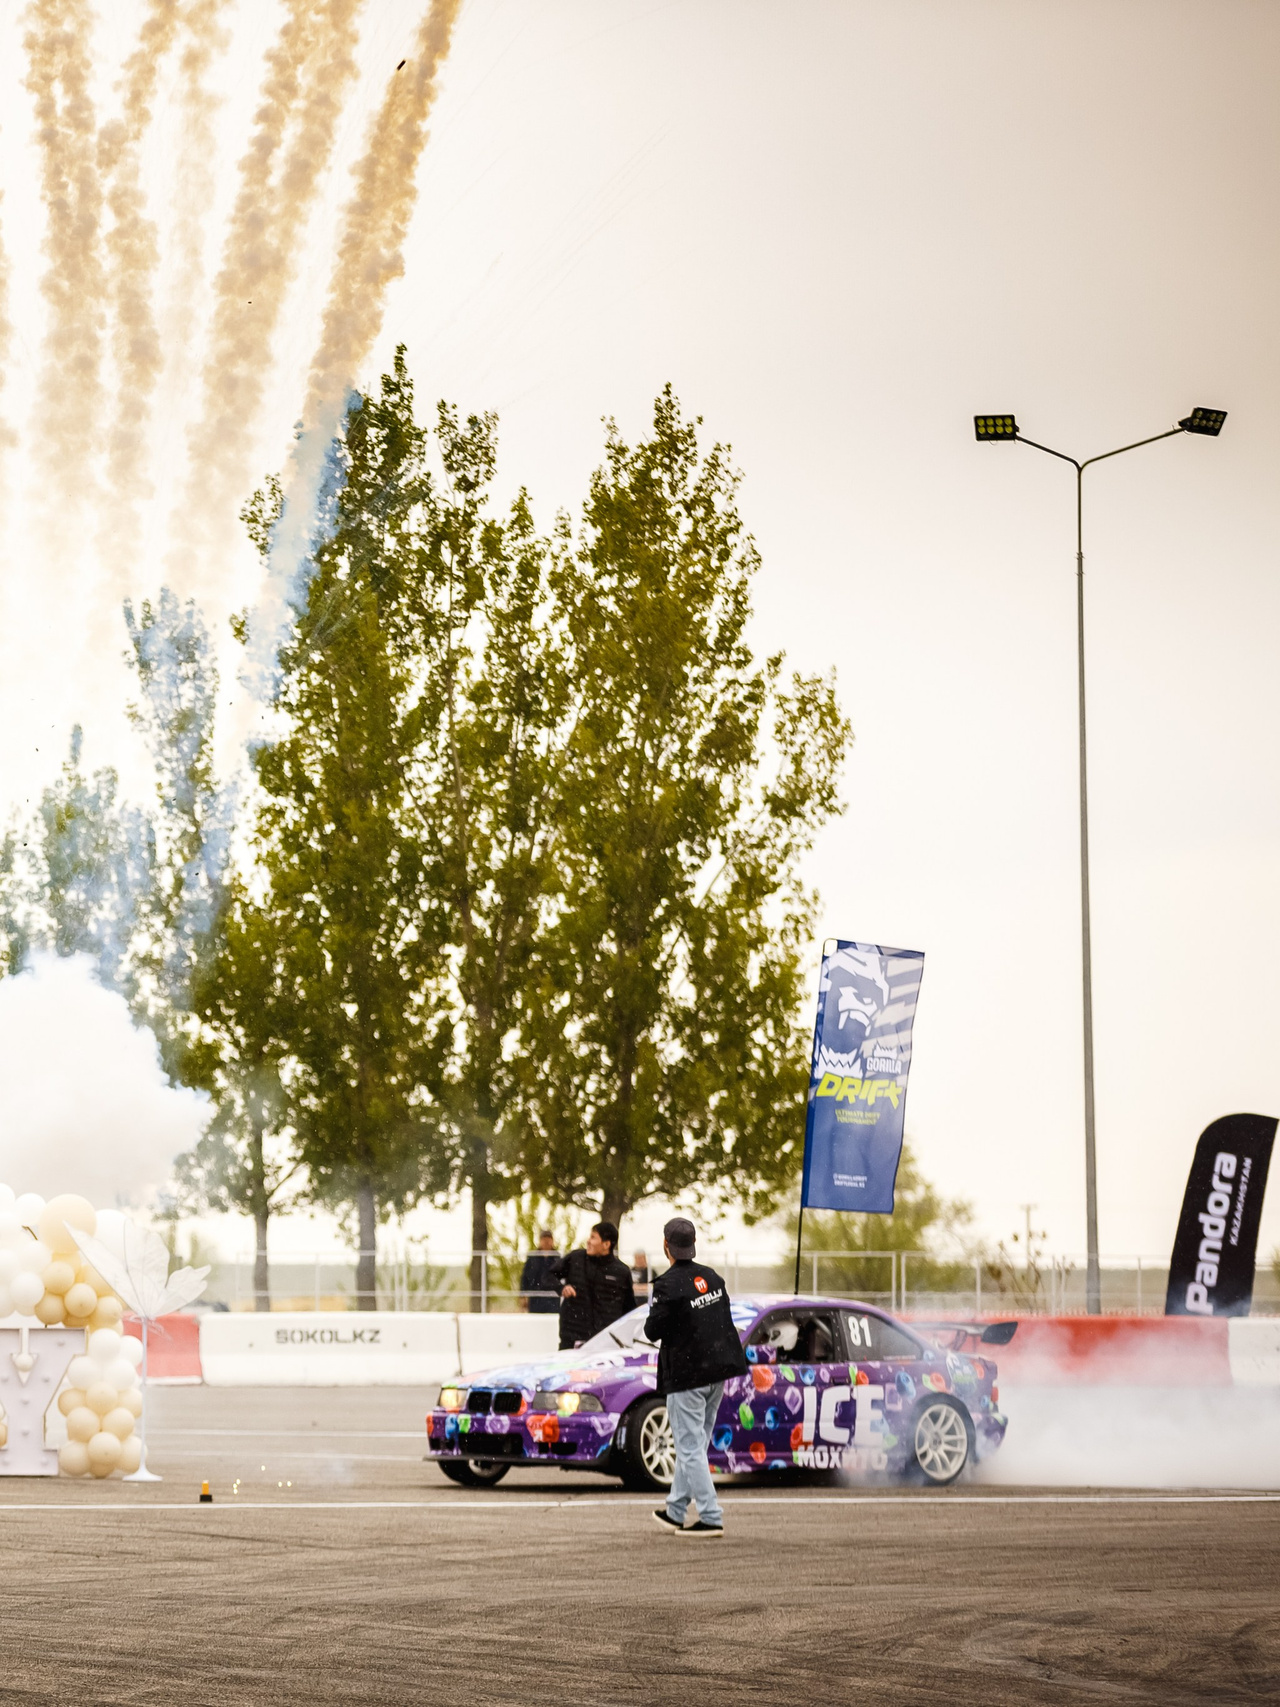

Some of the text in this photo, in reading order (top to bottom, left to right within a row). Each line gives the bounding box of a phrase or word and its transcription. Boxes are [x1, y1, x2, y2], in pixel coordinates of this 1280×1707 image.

[815, 1071, 903, 1110] DRIFT
[866, 1057, 902, 1074] GORILLA
[1229, 1156, 1252, 1247] KAZAKHSTAN
[1184, 1151, 1238, 1316] Pandora
[848, 1315, 872, 1347] 81
[802, 1384, 884, 1446] ICE
